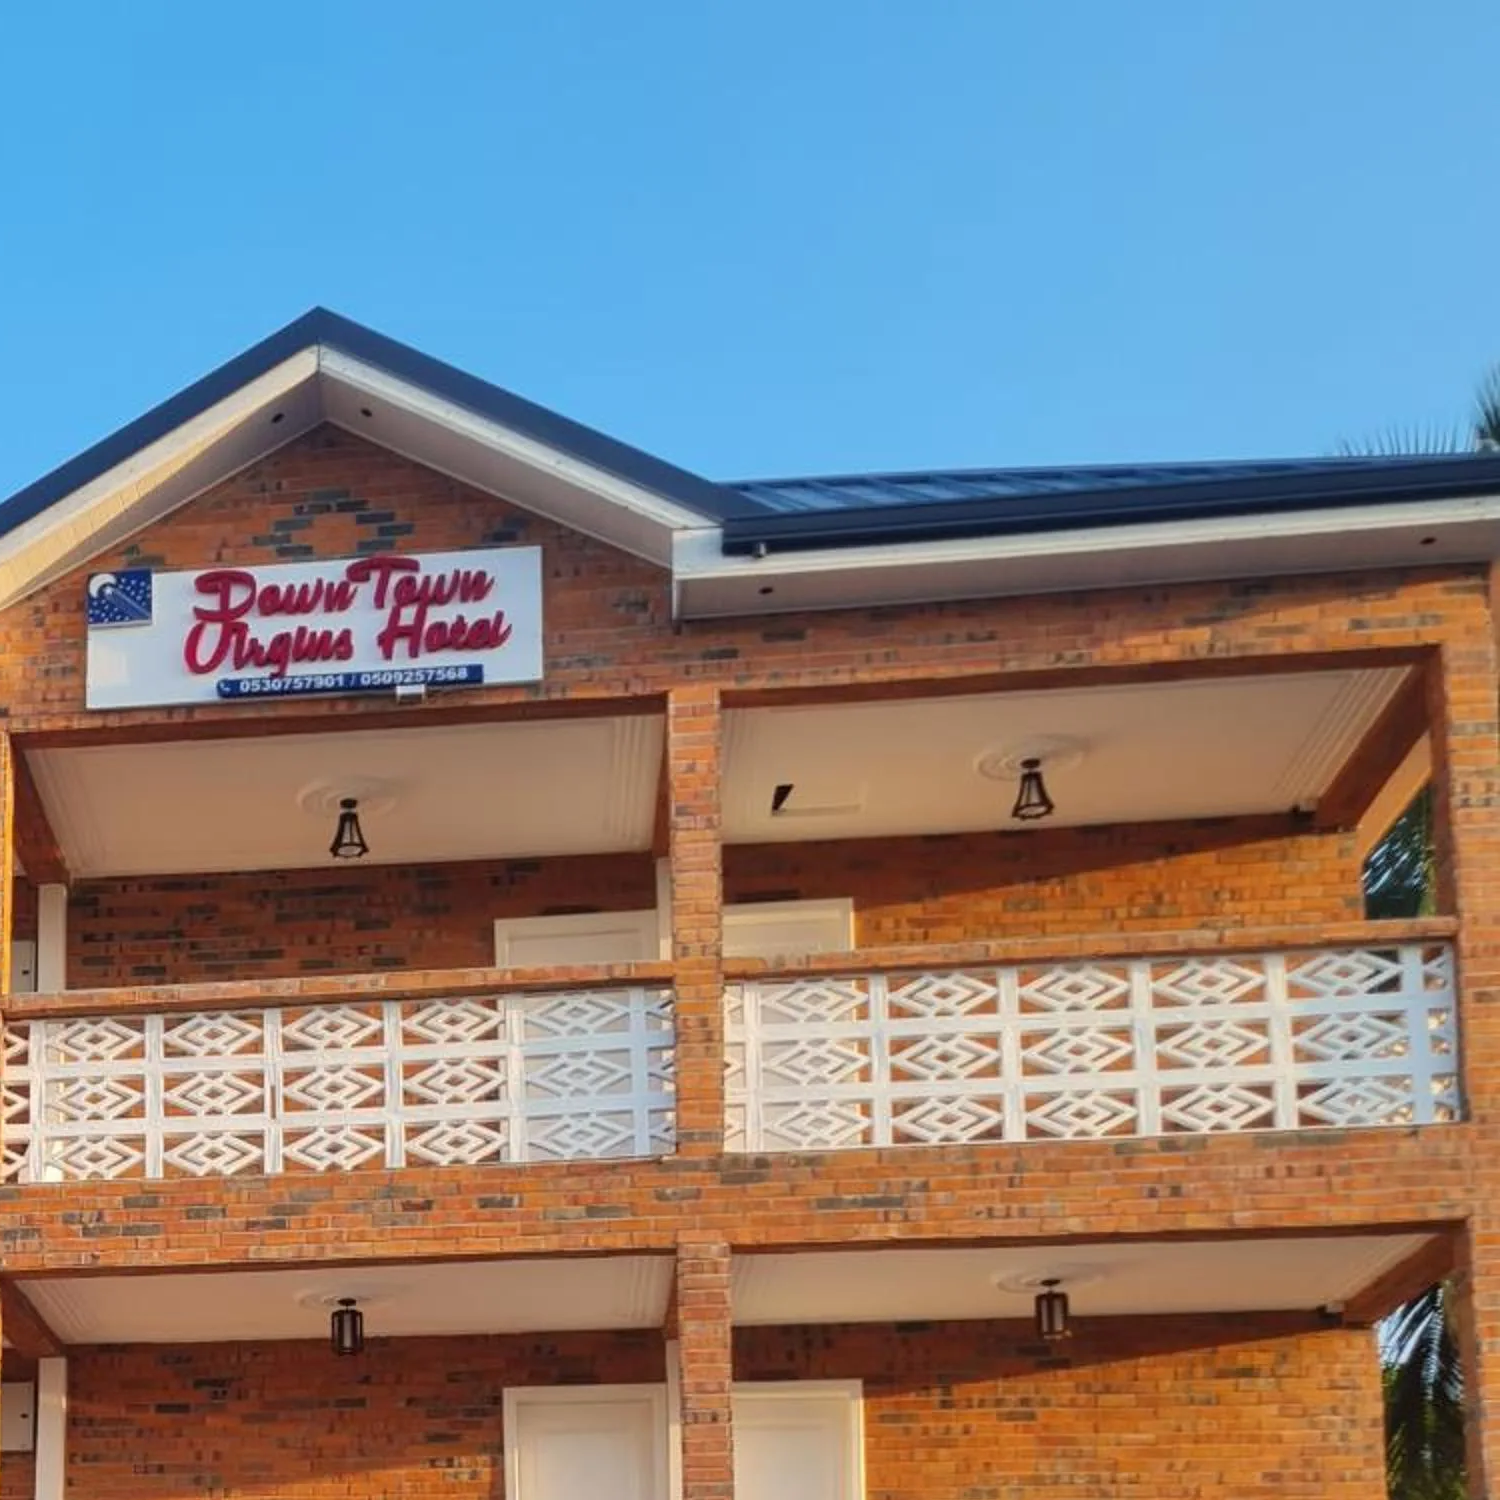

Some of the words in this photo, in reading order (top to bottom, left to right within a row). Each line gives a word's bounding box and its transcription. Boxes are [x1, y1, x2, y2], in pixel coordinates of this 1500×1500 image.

[193, 569, 358, 622] Down
[347, 556, 495, 609] Town
[377, 604, 513, 660] Hotel
[239, 674, 344, 693] 0530757901
[360, 667, 468, 686] 0509257568
